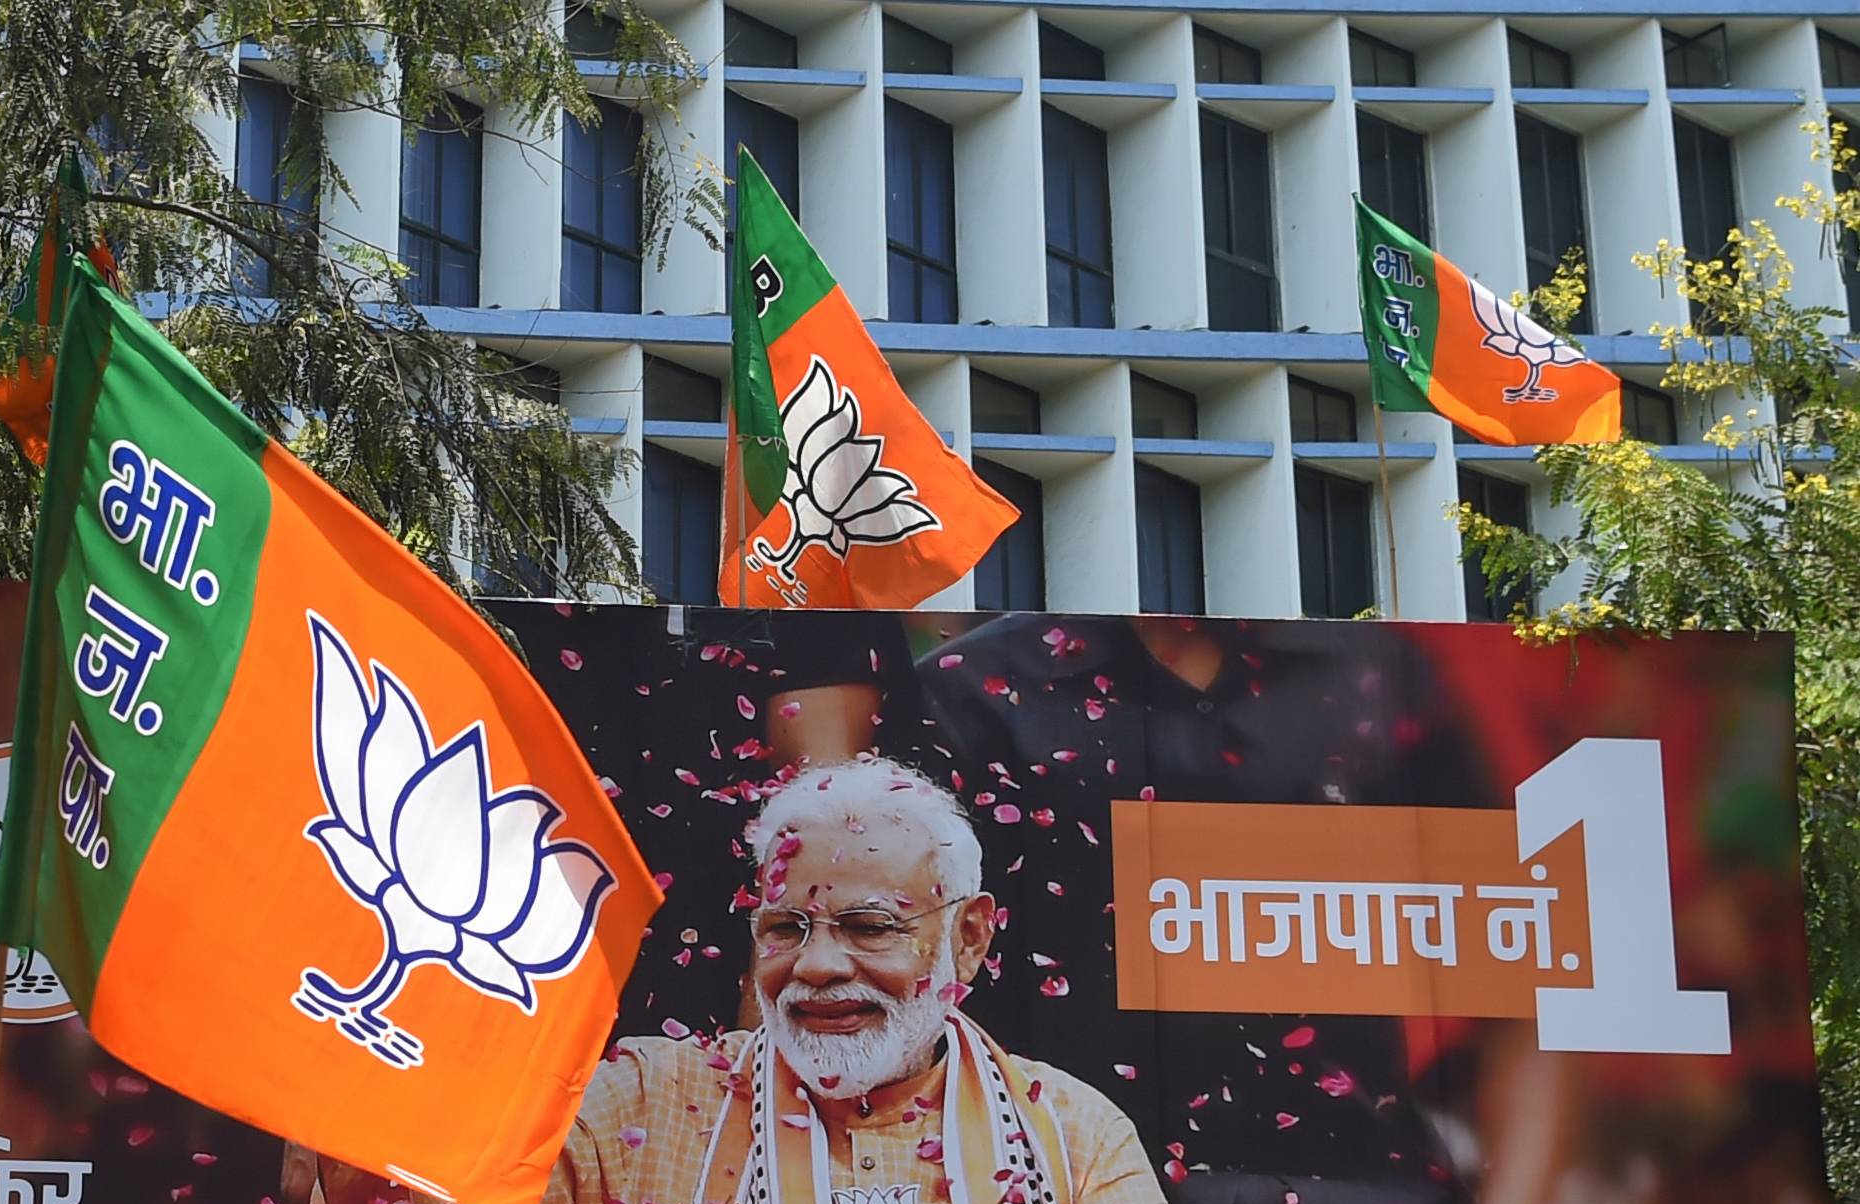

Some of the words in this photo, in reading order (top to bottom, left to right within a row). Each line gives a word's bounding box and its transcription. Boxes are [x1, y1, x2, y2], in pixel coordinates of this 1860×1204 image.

[99, 439, 219, 607] भा.
[73, 583, 169, 738] ज.
[58, 721, 116, 870] पा.
[1148, 877, 1463, 967] भाजपाच
[1476, 864, 1580, 972] नं.
[1514, 737, 1732, 1055] 1
